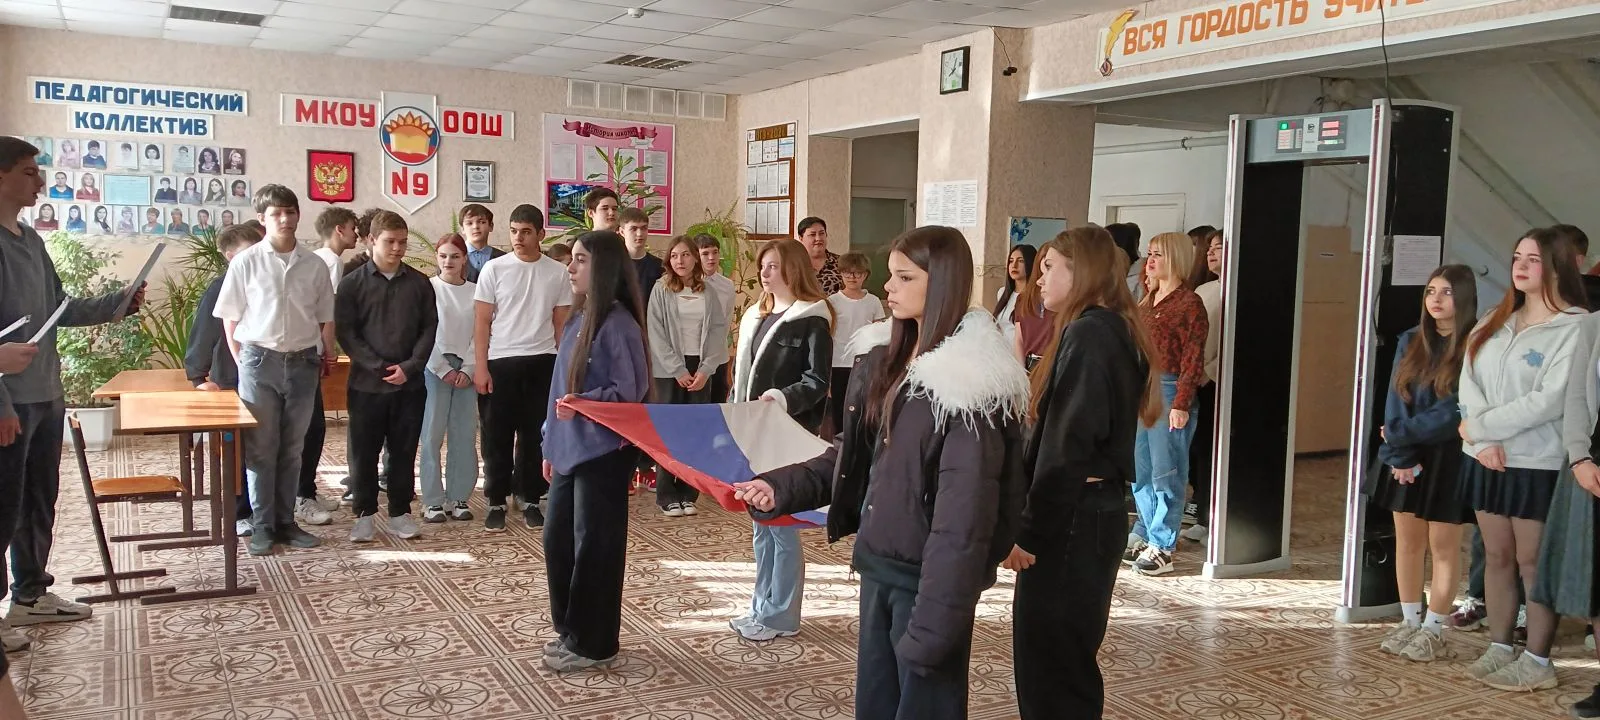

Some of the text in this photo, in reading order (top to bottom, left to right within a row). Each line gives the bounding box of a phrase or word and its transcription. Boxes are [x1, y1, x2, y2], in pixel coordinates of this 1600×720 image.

[1123, 19, 1168, 56] ВСЯ
[1178, 0, 1309, 45] ГОРДОСТЬ
[35, 80, 243, 112] ПЕДАГОГИЧЕСКИЙ
[74, 111, 208, 136] КОЛЛЕКТИВ
[295, 98, 502, 137] МКОУ ООШ
